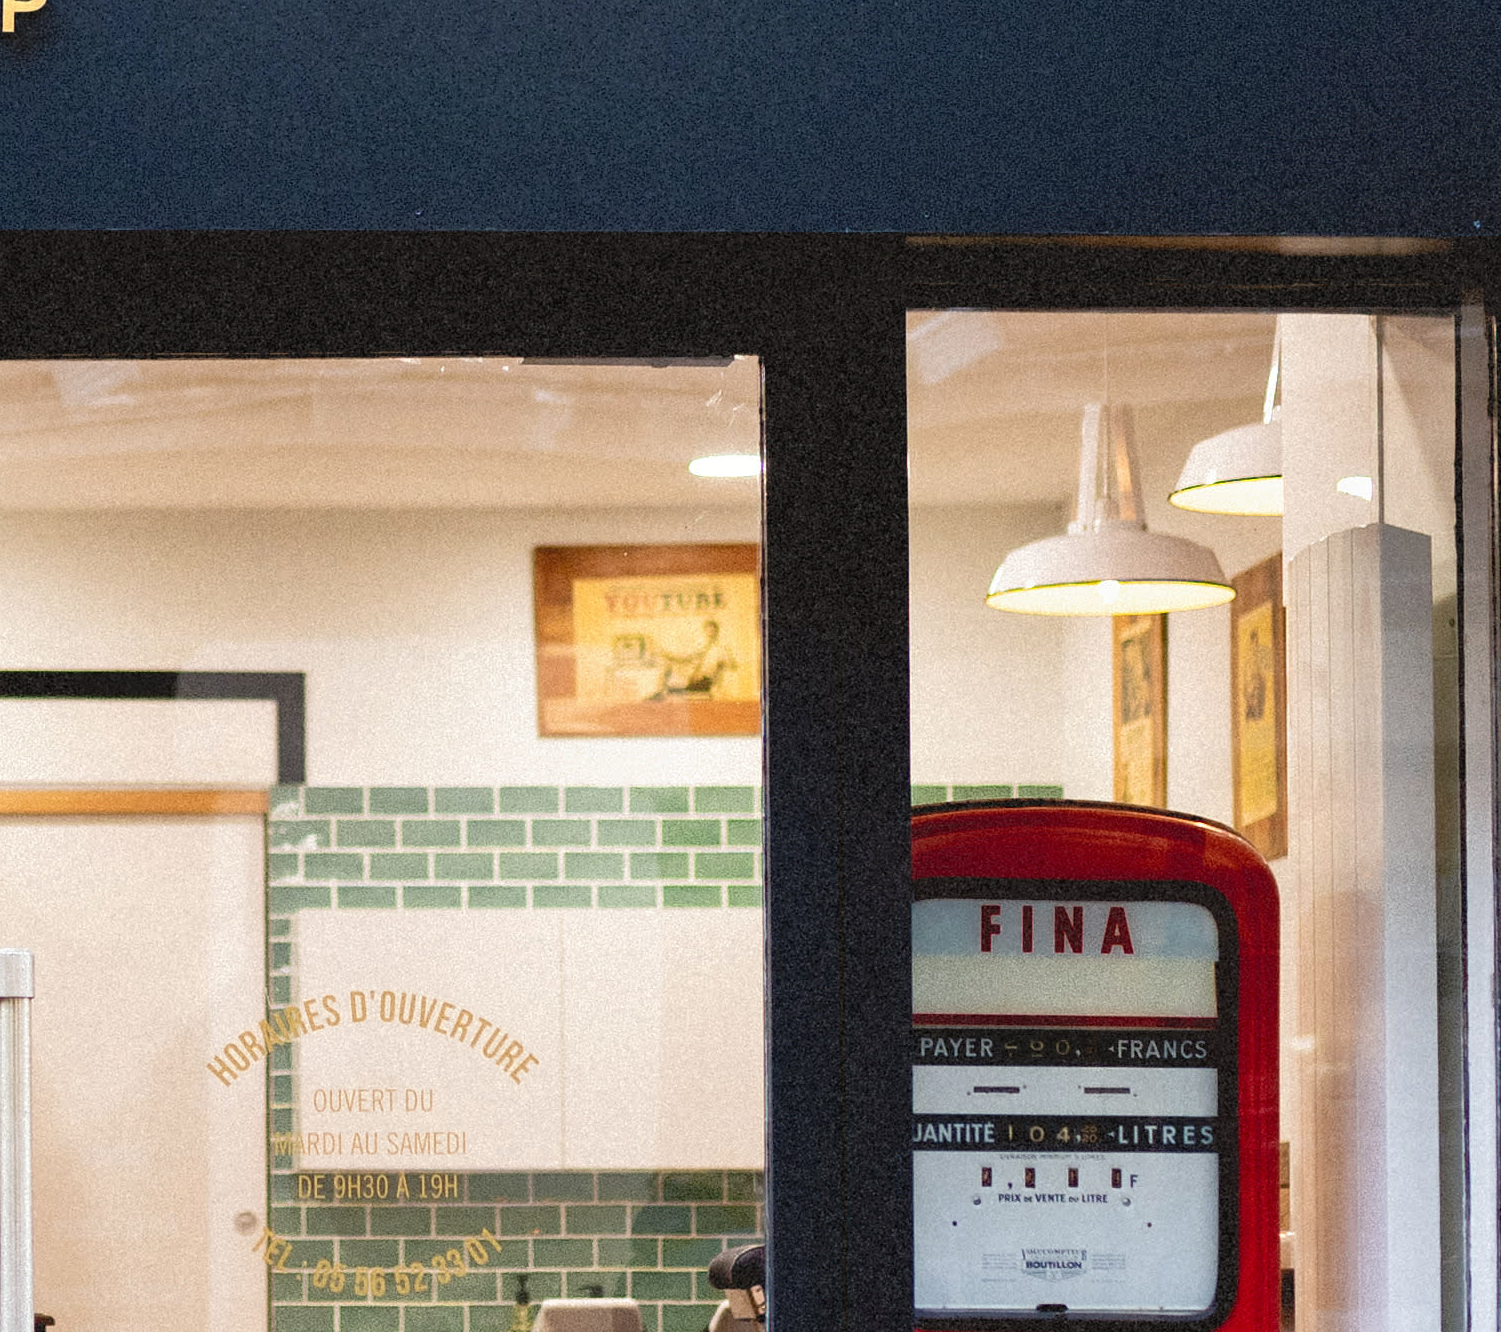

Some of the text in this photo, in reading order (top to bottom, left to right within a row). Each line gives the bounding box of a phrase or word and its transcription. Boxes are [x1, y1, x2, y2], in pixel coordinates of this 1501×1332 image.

[979, 904, 1135, 955] FINA
[207, 990, 540, 1087] HORAIRES D'OUVERTURE
[920, 1038, 995, 1058] PAYER
[1117, 1039, 1208, 1060] FRANCS
[313, 1088, 435, 1113] OUVERT DU
[273, 1131, 468, 1156] MARDI AU SAMEDI
[1118, 1125, 1214, 1145] LITRES
[297, 1174, 460, 1200] DE 9H30 19H
[998, 1193, 1022, 1204] PRIX
[1034, 1193, 1066, 1204] VENTE
[1081, 1194, 1108, 1204] LITRE
[312, 1258, 347, 1294] 05
[354, 1266, 387, 1297] 56
[394, 1262, 429, 1296] 52
[464, 1227, 503, 1266] 01
